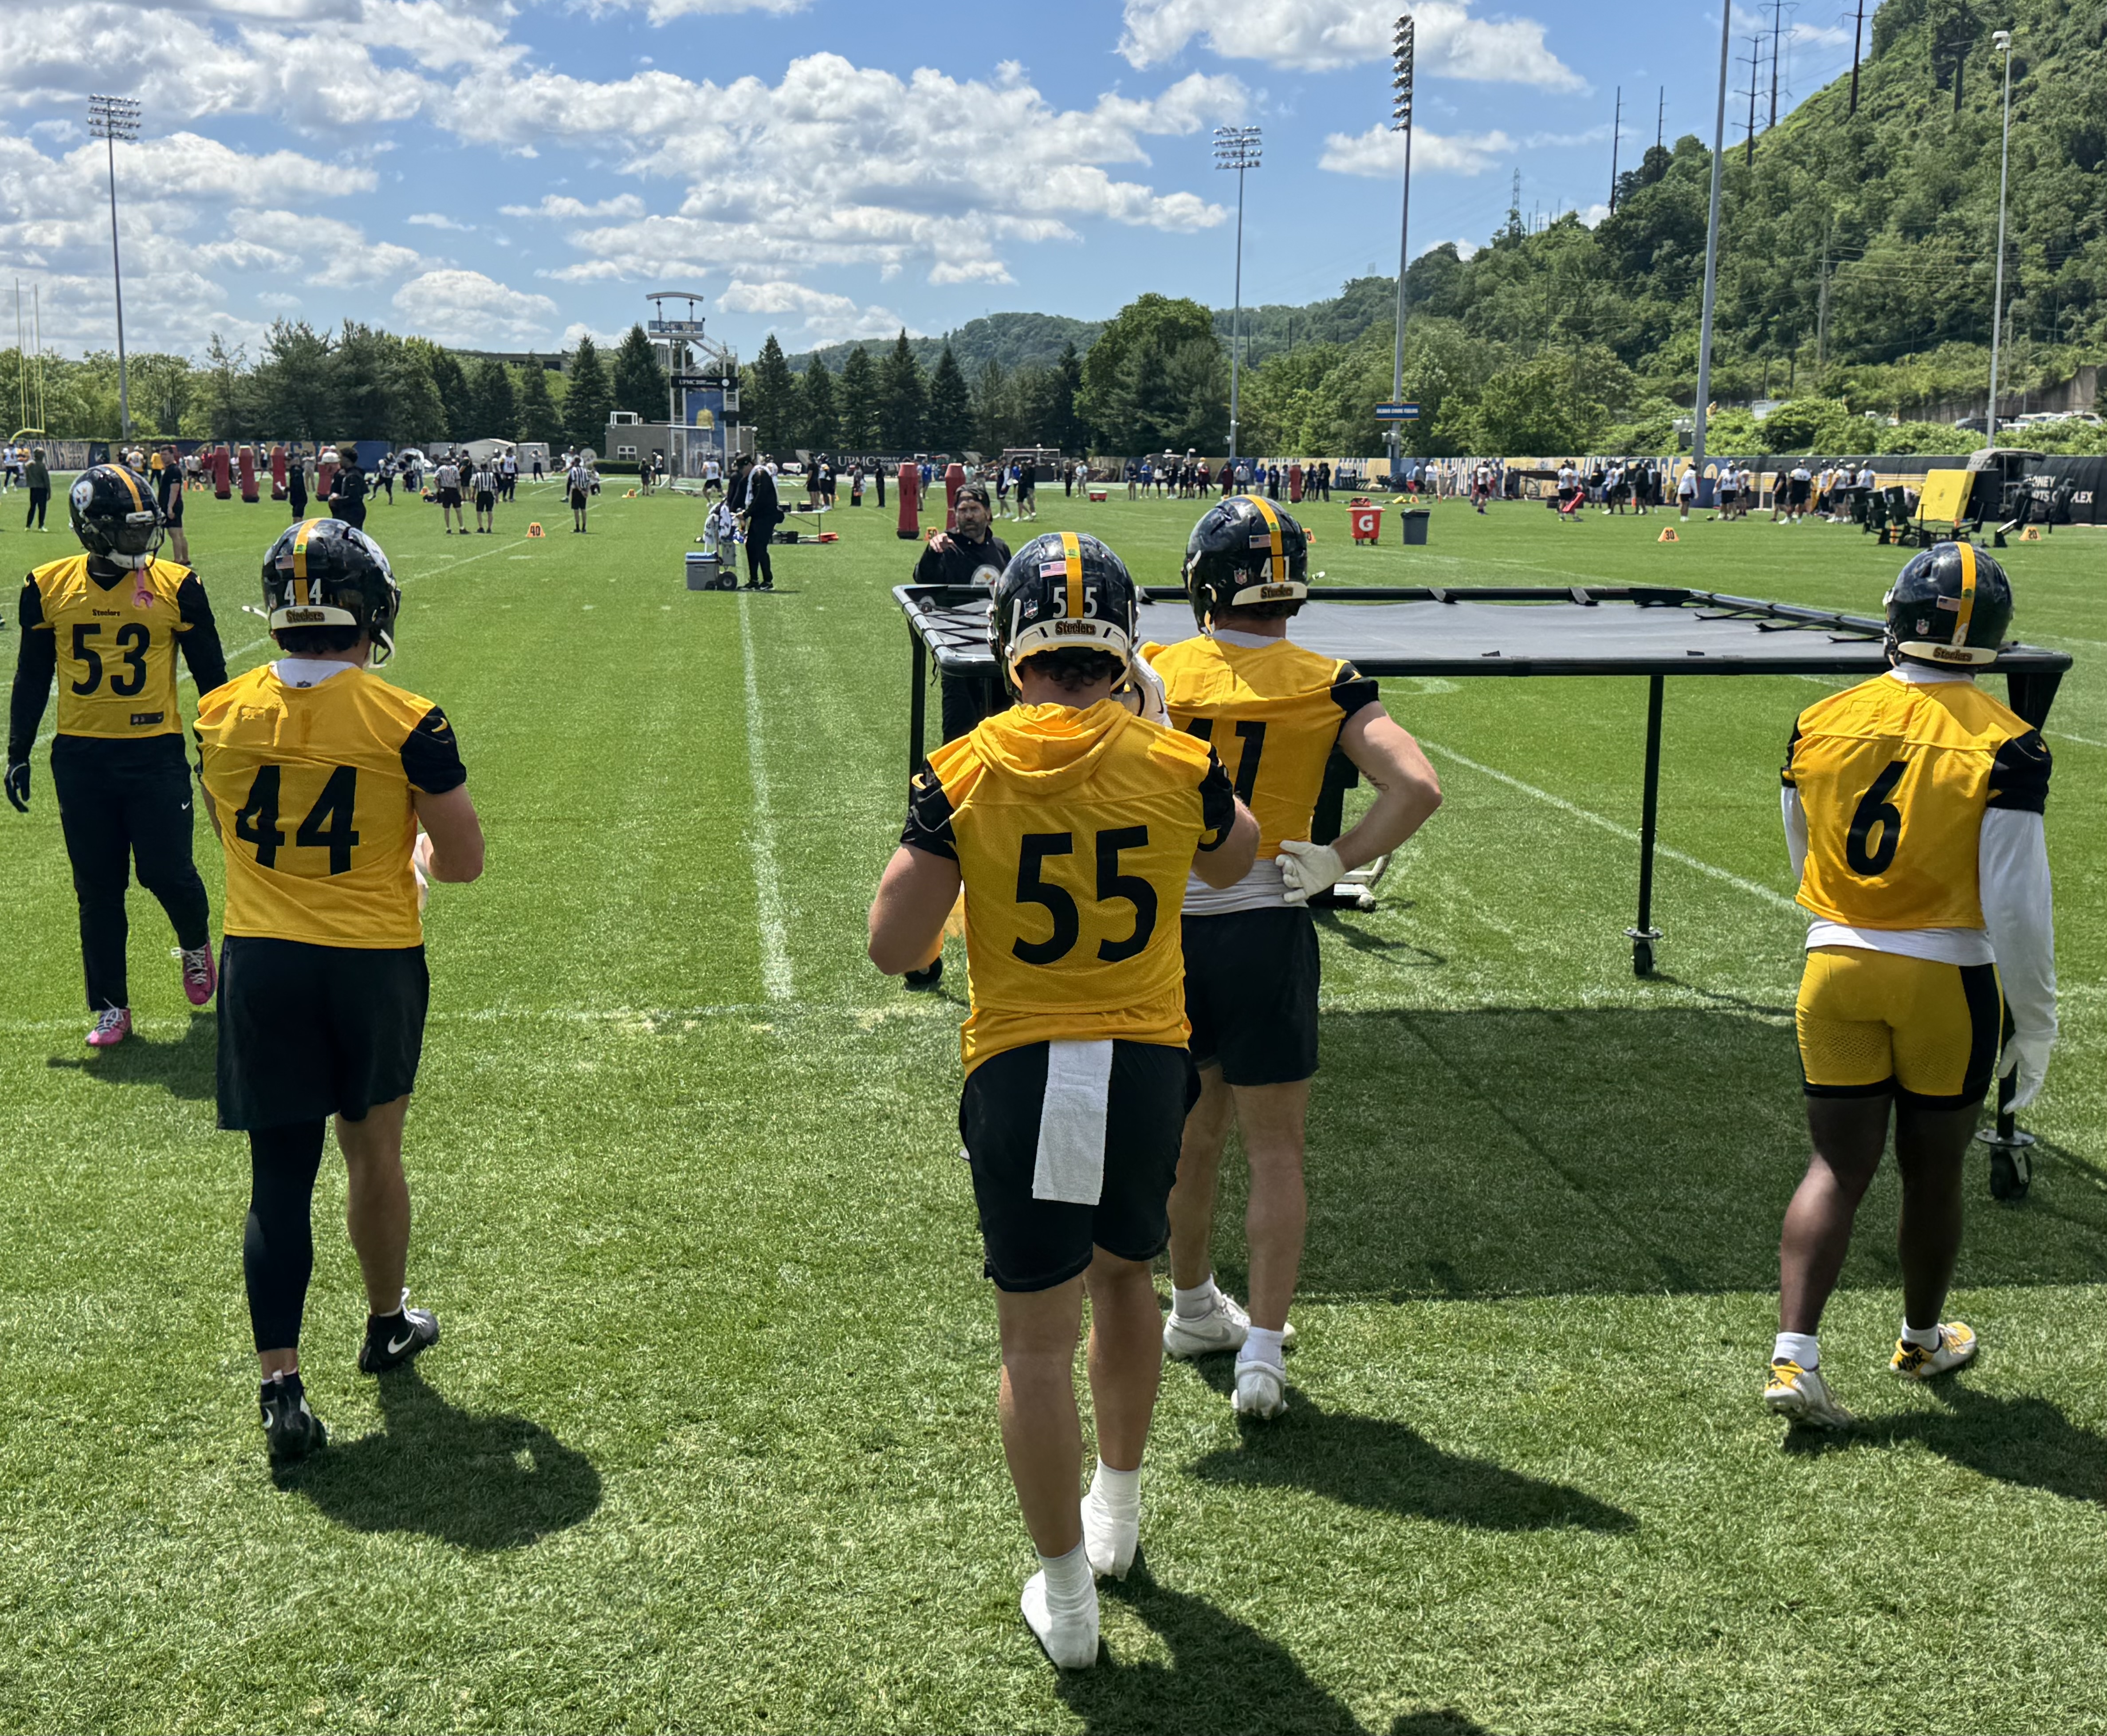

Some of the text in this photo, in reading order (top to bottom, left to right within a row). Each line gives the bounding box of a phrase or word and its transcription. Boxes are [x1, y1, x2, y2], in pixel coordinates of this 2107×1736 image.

[837, 456, 876, 467] UPMC
[530, 525, 541, 536] 40
[1358, 515, 1374, 532] G
[928, 529, 937, 539] 50
[1665, 530, 1675, 540] 30
[2028, 529, 2038, 540] 20
[1260, 556, 1290, 583] 41
[284, 578, 323, 606] 44
[1052, 587, 1097, 618] 55
[286, 608, 325, 623] Steelers
[1055, 619, 1096, 635] Steelers
[1951, 623, 1968, 646] 6
[71, 622, 150, 696] 53
[235, 765, 360, 876] 44
[1846, 760, 1908, 876] 6
[1011, 825, 1158, 965] 55
